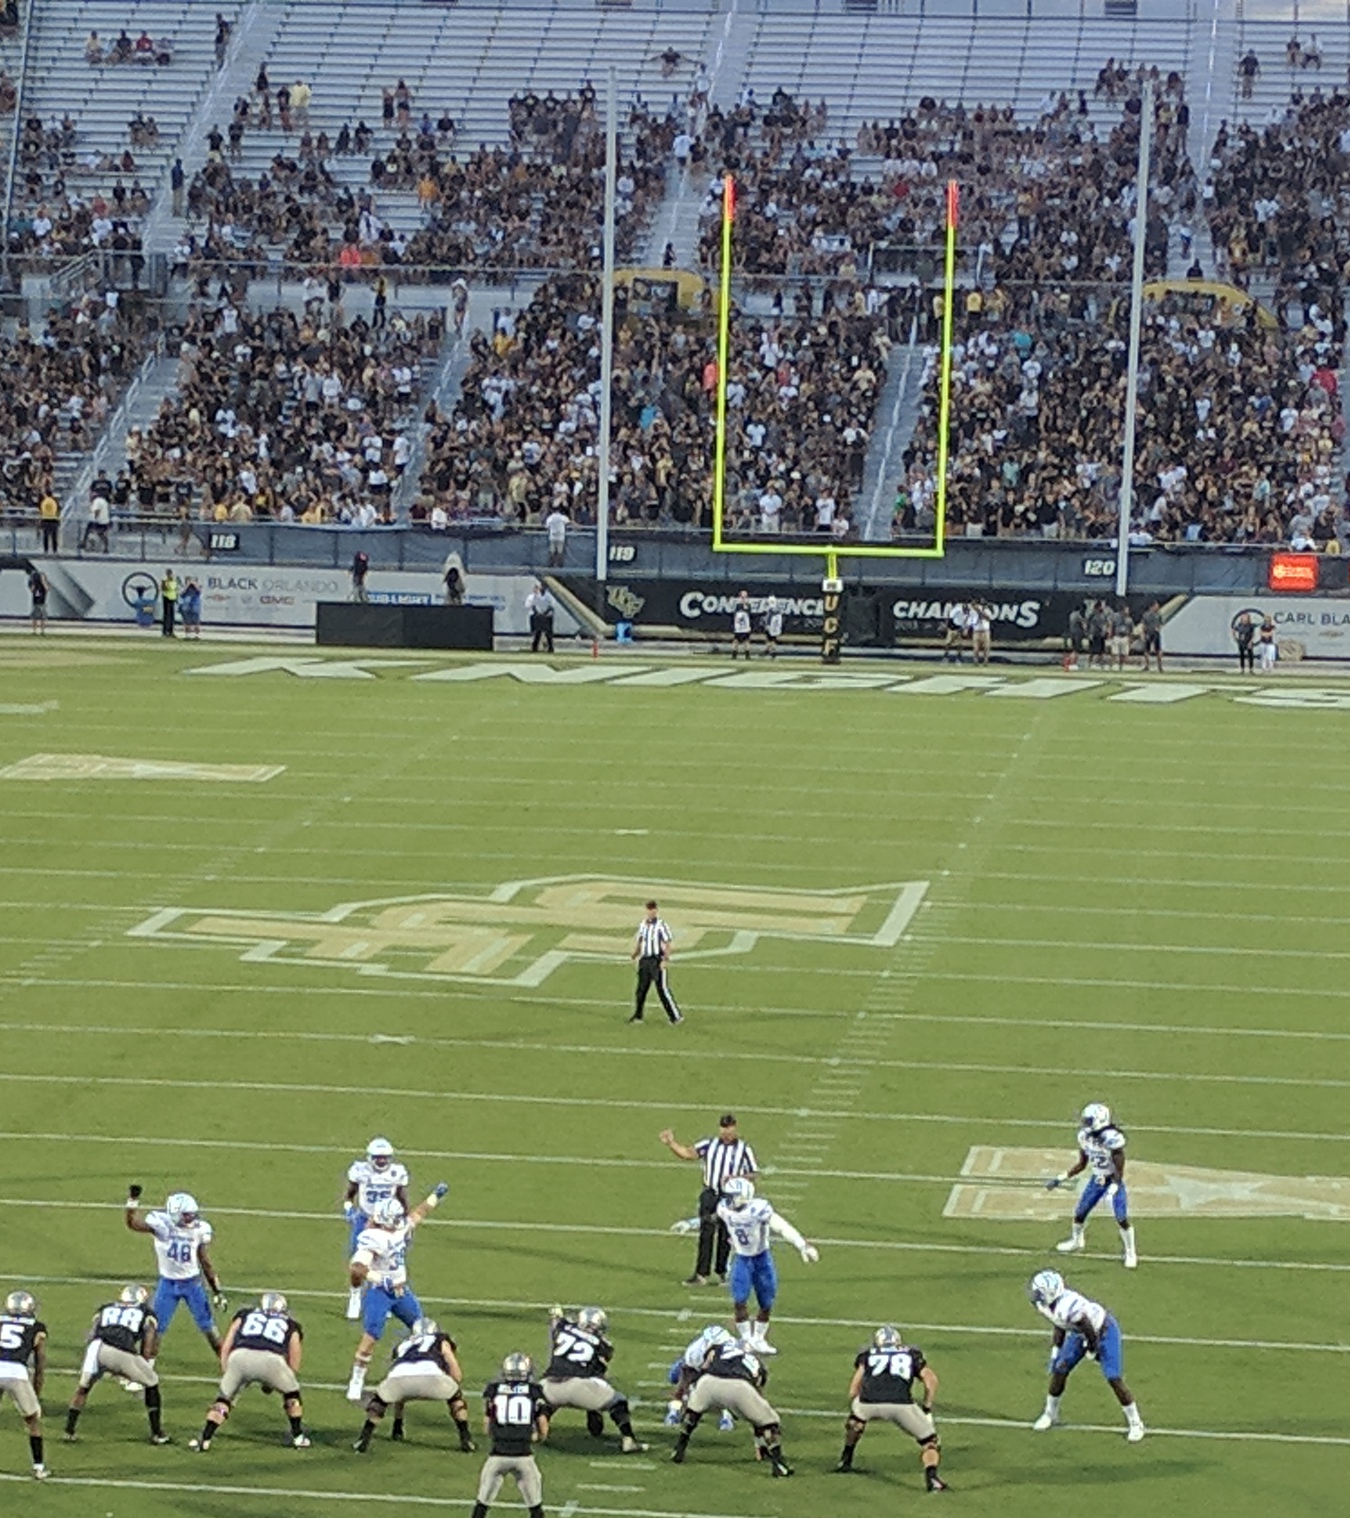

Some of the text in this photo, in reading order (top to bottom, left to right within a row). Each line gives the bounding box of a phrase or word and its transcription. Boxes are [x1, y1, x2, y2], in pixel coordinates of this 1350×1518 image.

[211, 534, 237, 549] 118
[1084, 558, 1116, 576] 120
[207, 577, 259, 590] BLACK
[262, 580, 339, 594] ORLANDO
[1273, 612, 1316, 626] CARL
[100, 1305, 144, 1334] 88
[241, 1312, 289, 1344] 66
[867, 1353, 913, 1380] 78
[493, 1394, 533, 1425] 10
